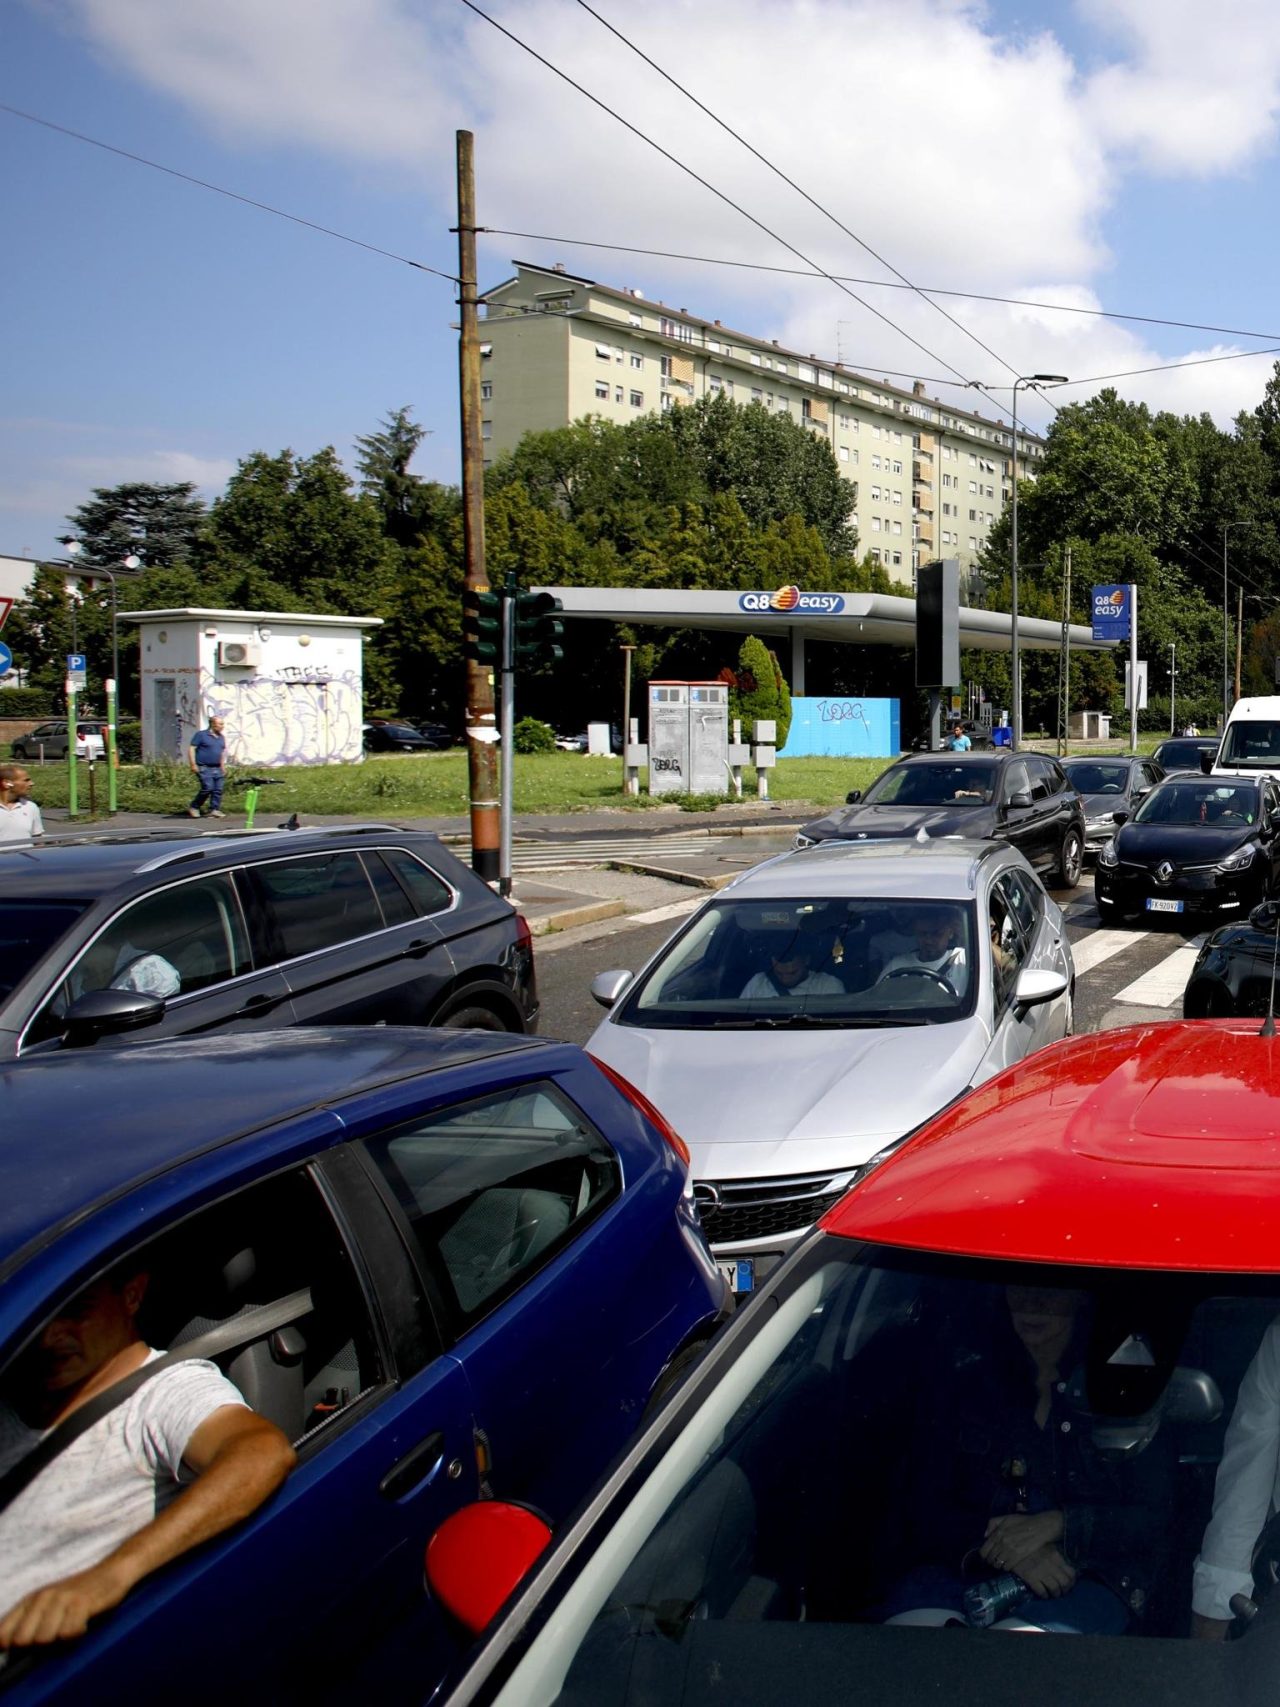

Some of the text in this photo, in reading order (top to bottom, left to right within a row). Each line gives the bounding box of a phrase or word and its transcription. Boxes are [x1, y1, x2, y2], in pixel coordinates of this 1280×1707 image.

[743, 594, 840, 612] Q8 easy
[1094, 596, 1109, 605] Q8
[1094, 605, 1124, 618] easy
[71, 656, 82, 669] P
